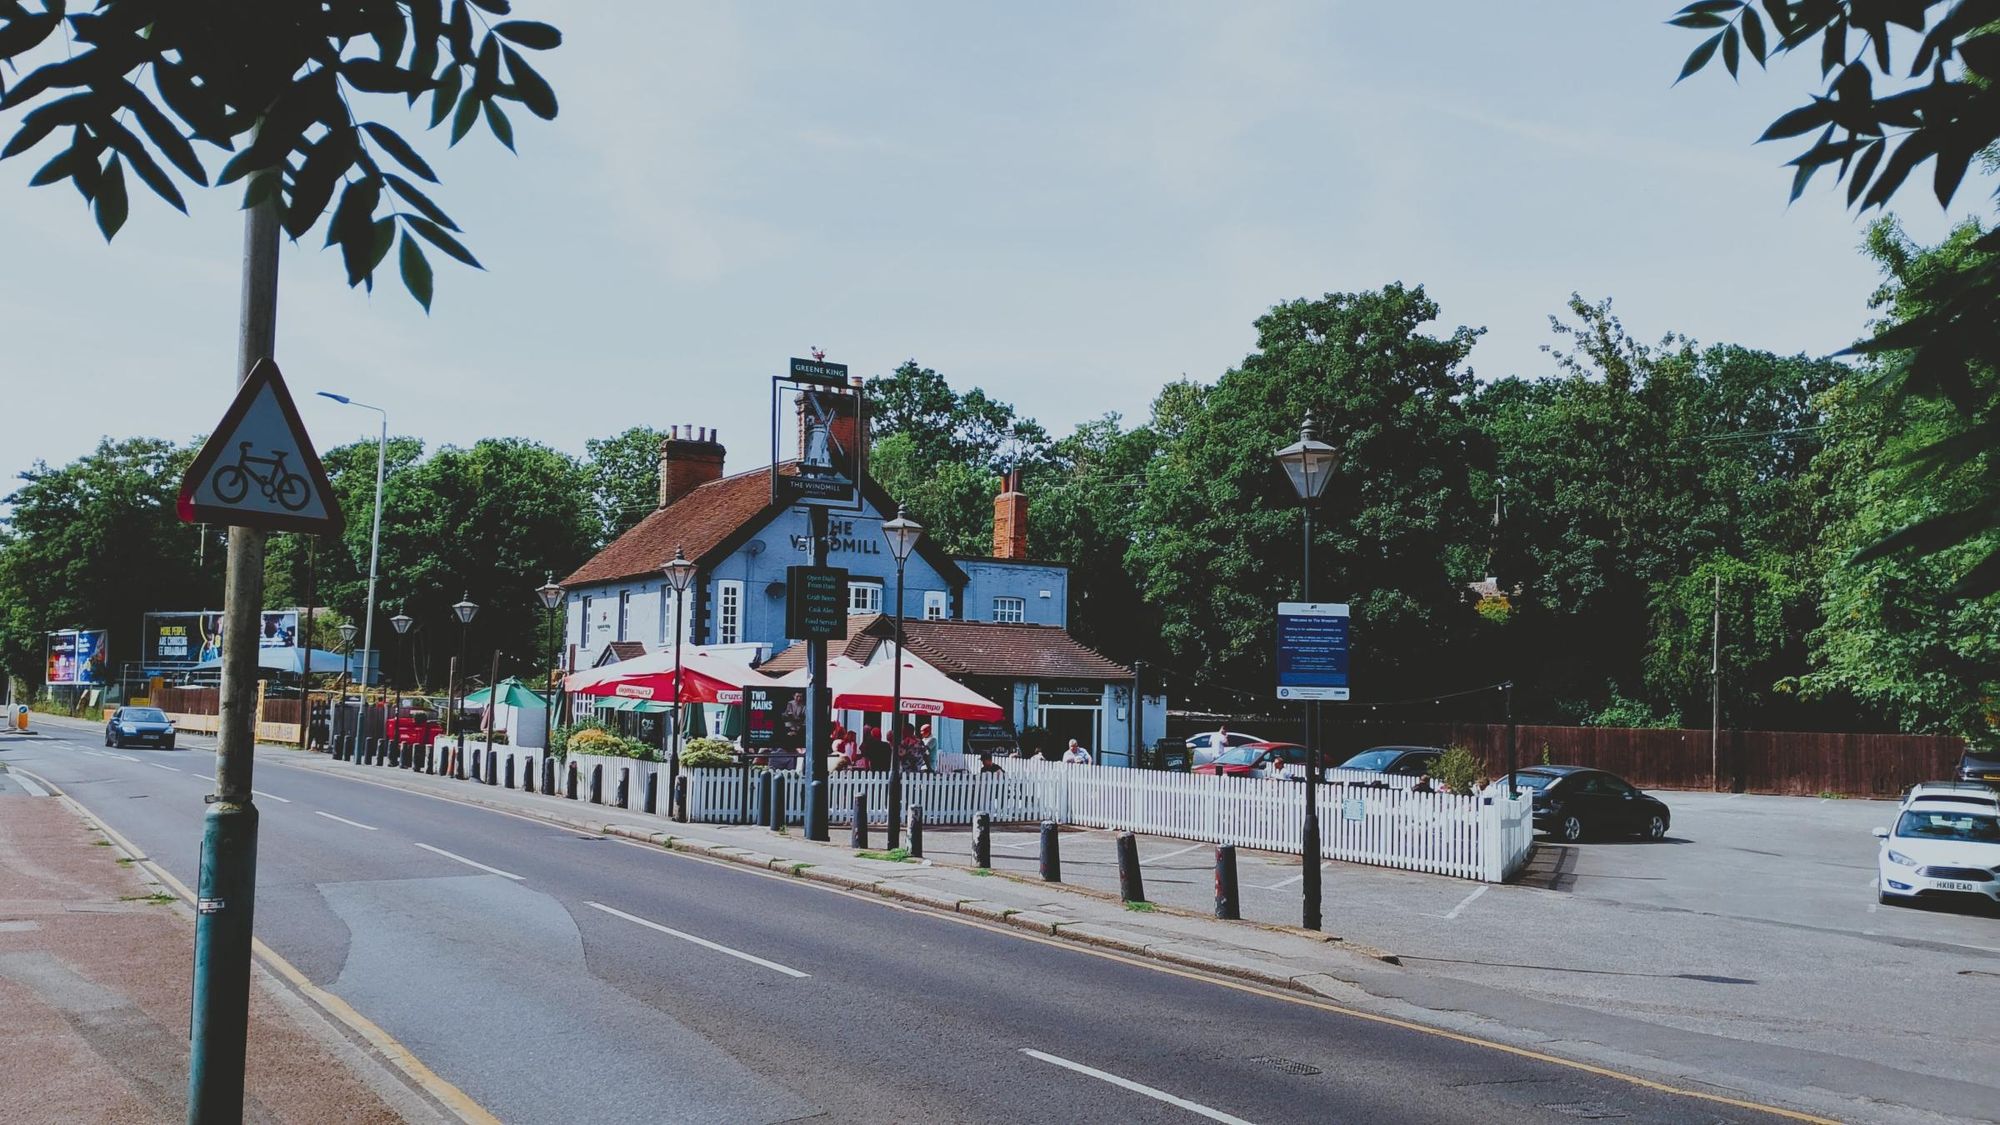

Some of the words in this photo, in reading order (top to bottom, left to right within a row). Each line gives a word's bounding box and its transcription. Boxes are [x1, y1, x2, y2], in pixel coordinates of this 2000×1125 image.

[795, 364, 824, 374] GREENE
[826, 368, 844, 376] KING
[805, 482, 840, 491] WINDMILL
[830, 520, 852, 535] HE
[160, 626, 170, 635] MORE
[172, 626, 186, 635] PEOPLE
[159, 636, 168, 645] ARE
[751, 691, 766, 700] TWO
[751, 701, 773, 710] MAINS
[902, 701, 940, 711] Cruzcampo
